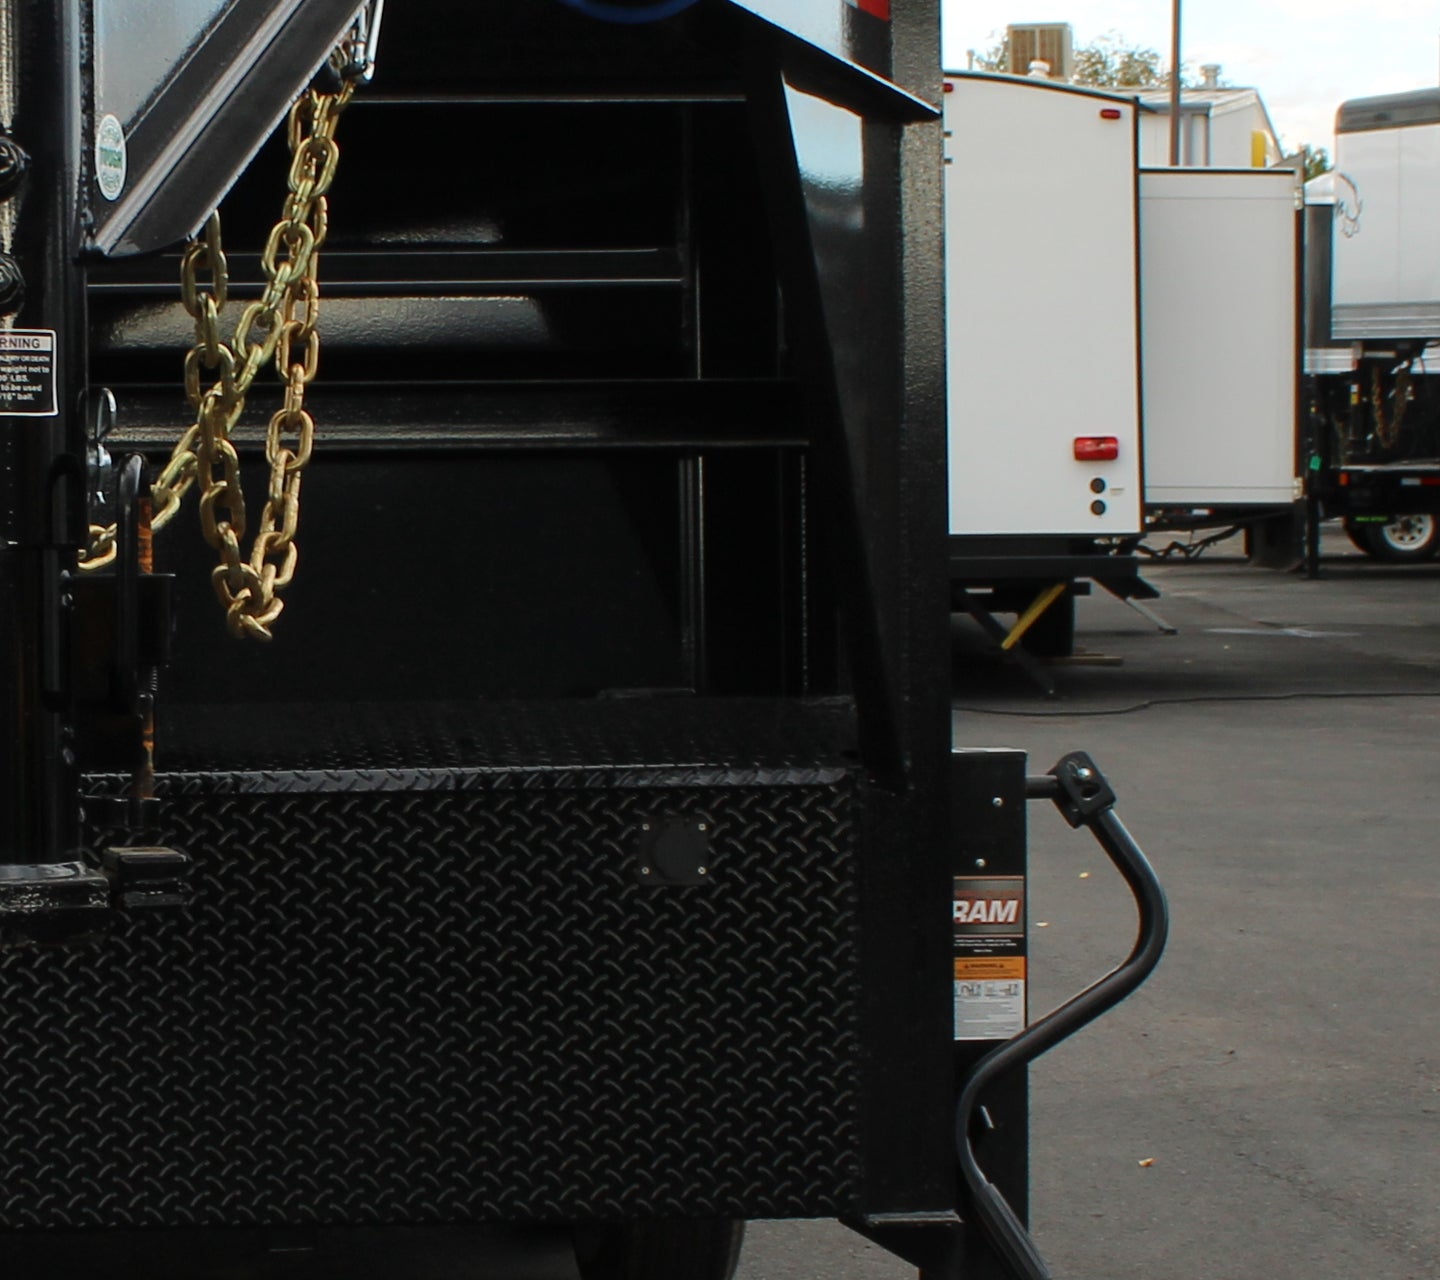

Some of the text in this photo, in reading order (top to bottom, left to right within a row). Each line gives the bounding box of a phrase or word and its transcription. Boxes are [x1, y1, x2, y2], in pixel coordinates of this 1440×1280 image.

[0, 365, 27, 374] weight
[22, 384, 42, 392] used
[952, 899, 1019, 923] RAM
